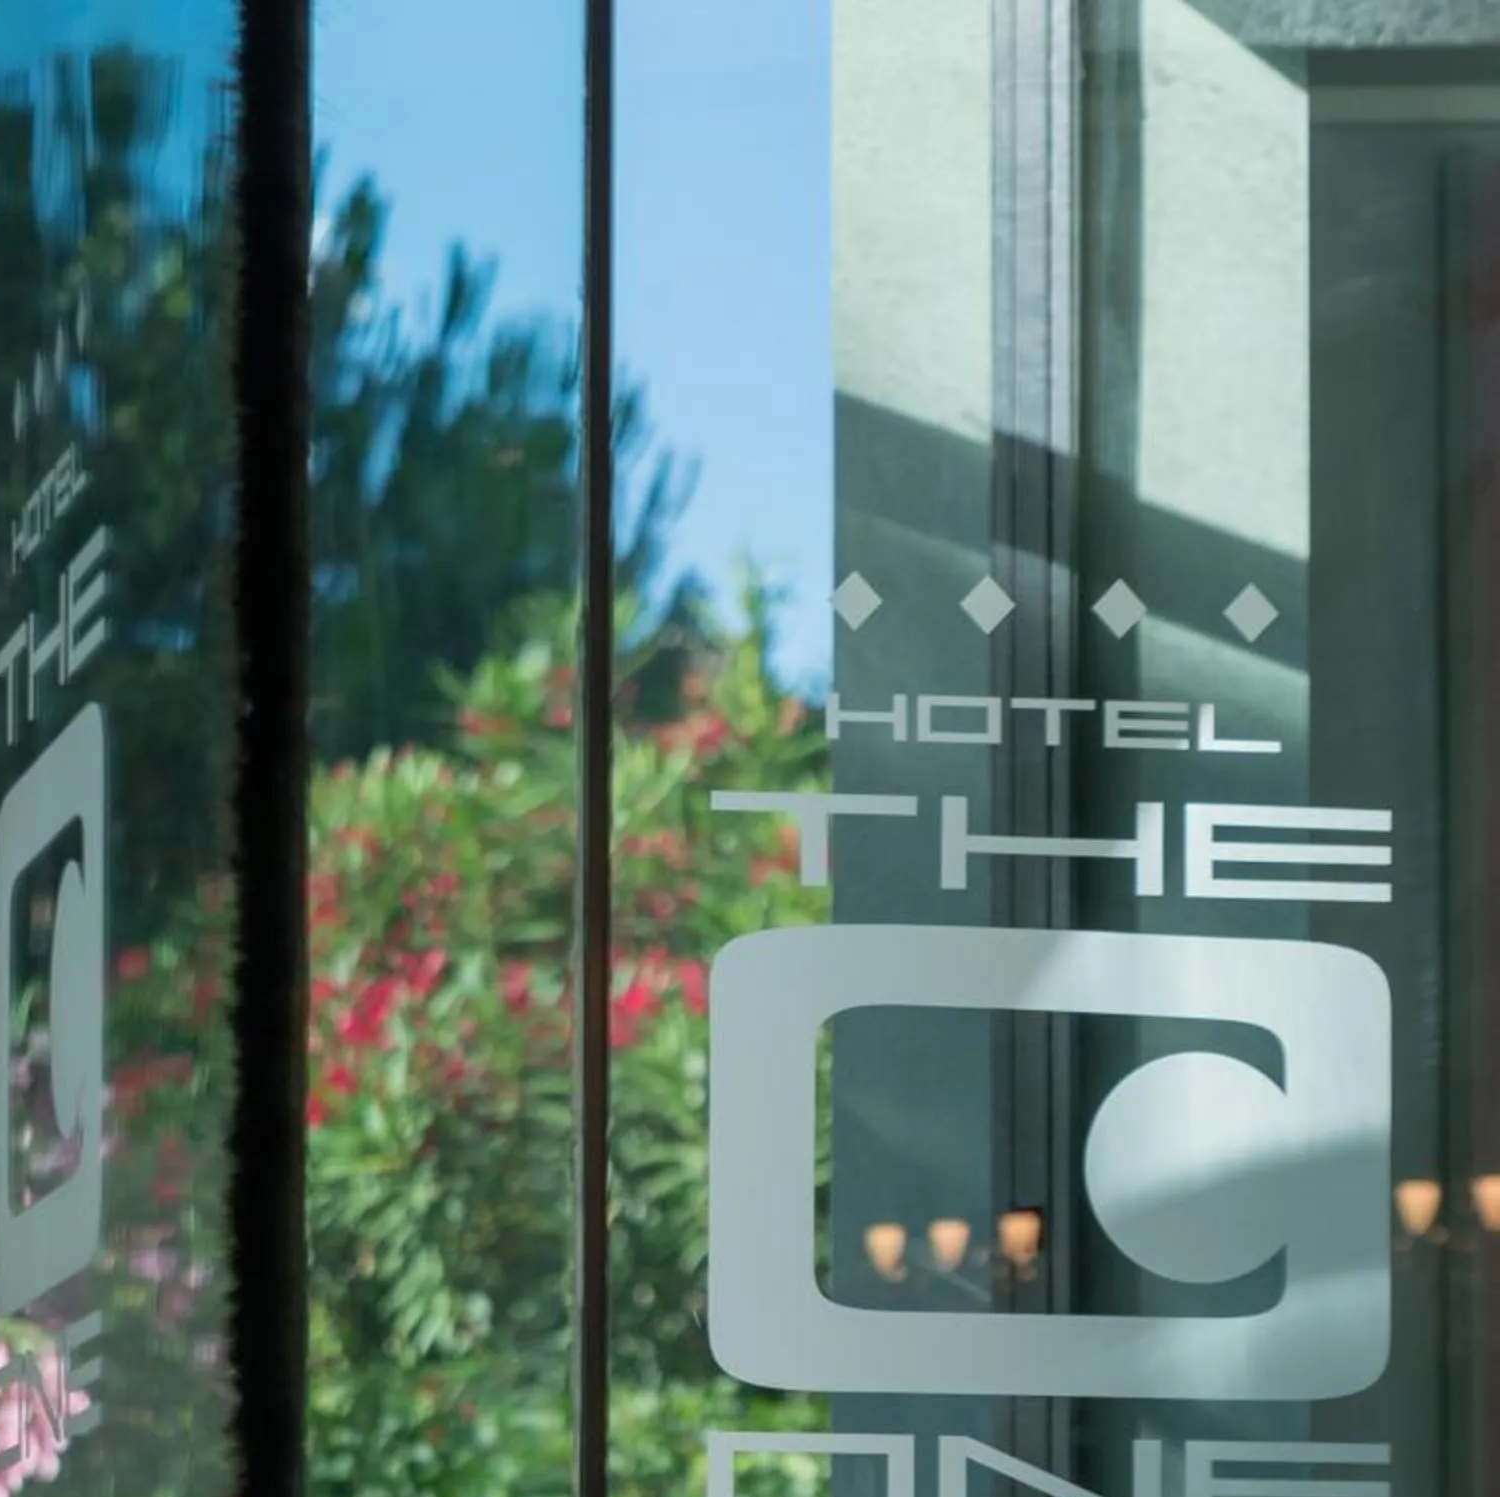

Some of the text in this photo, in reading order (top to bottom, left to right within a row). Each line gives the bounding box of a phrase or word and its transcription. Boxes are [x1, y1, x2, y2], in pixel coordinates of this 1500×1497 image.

[11, 440, 90, 576] HOTEL
[825, 692, 1282, 753] HOTEL
[709, 790, 1393, 902] THE
